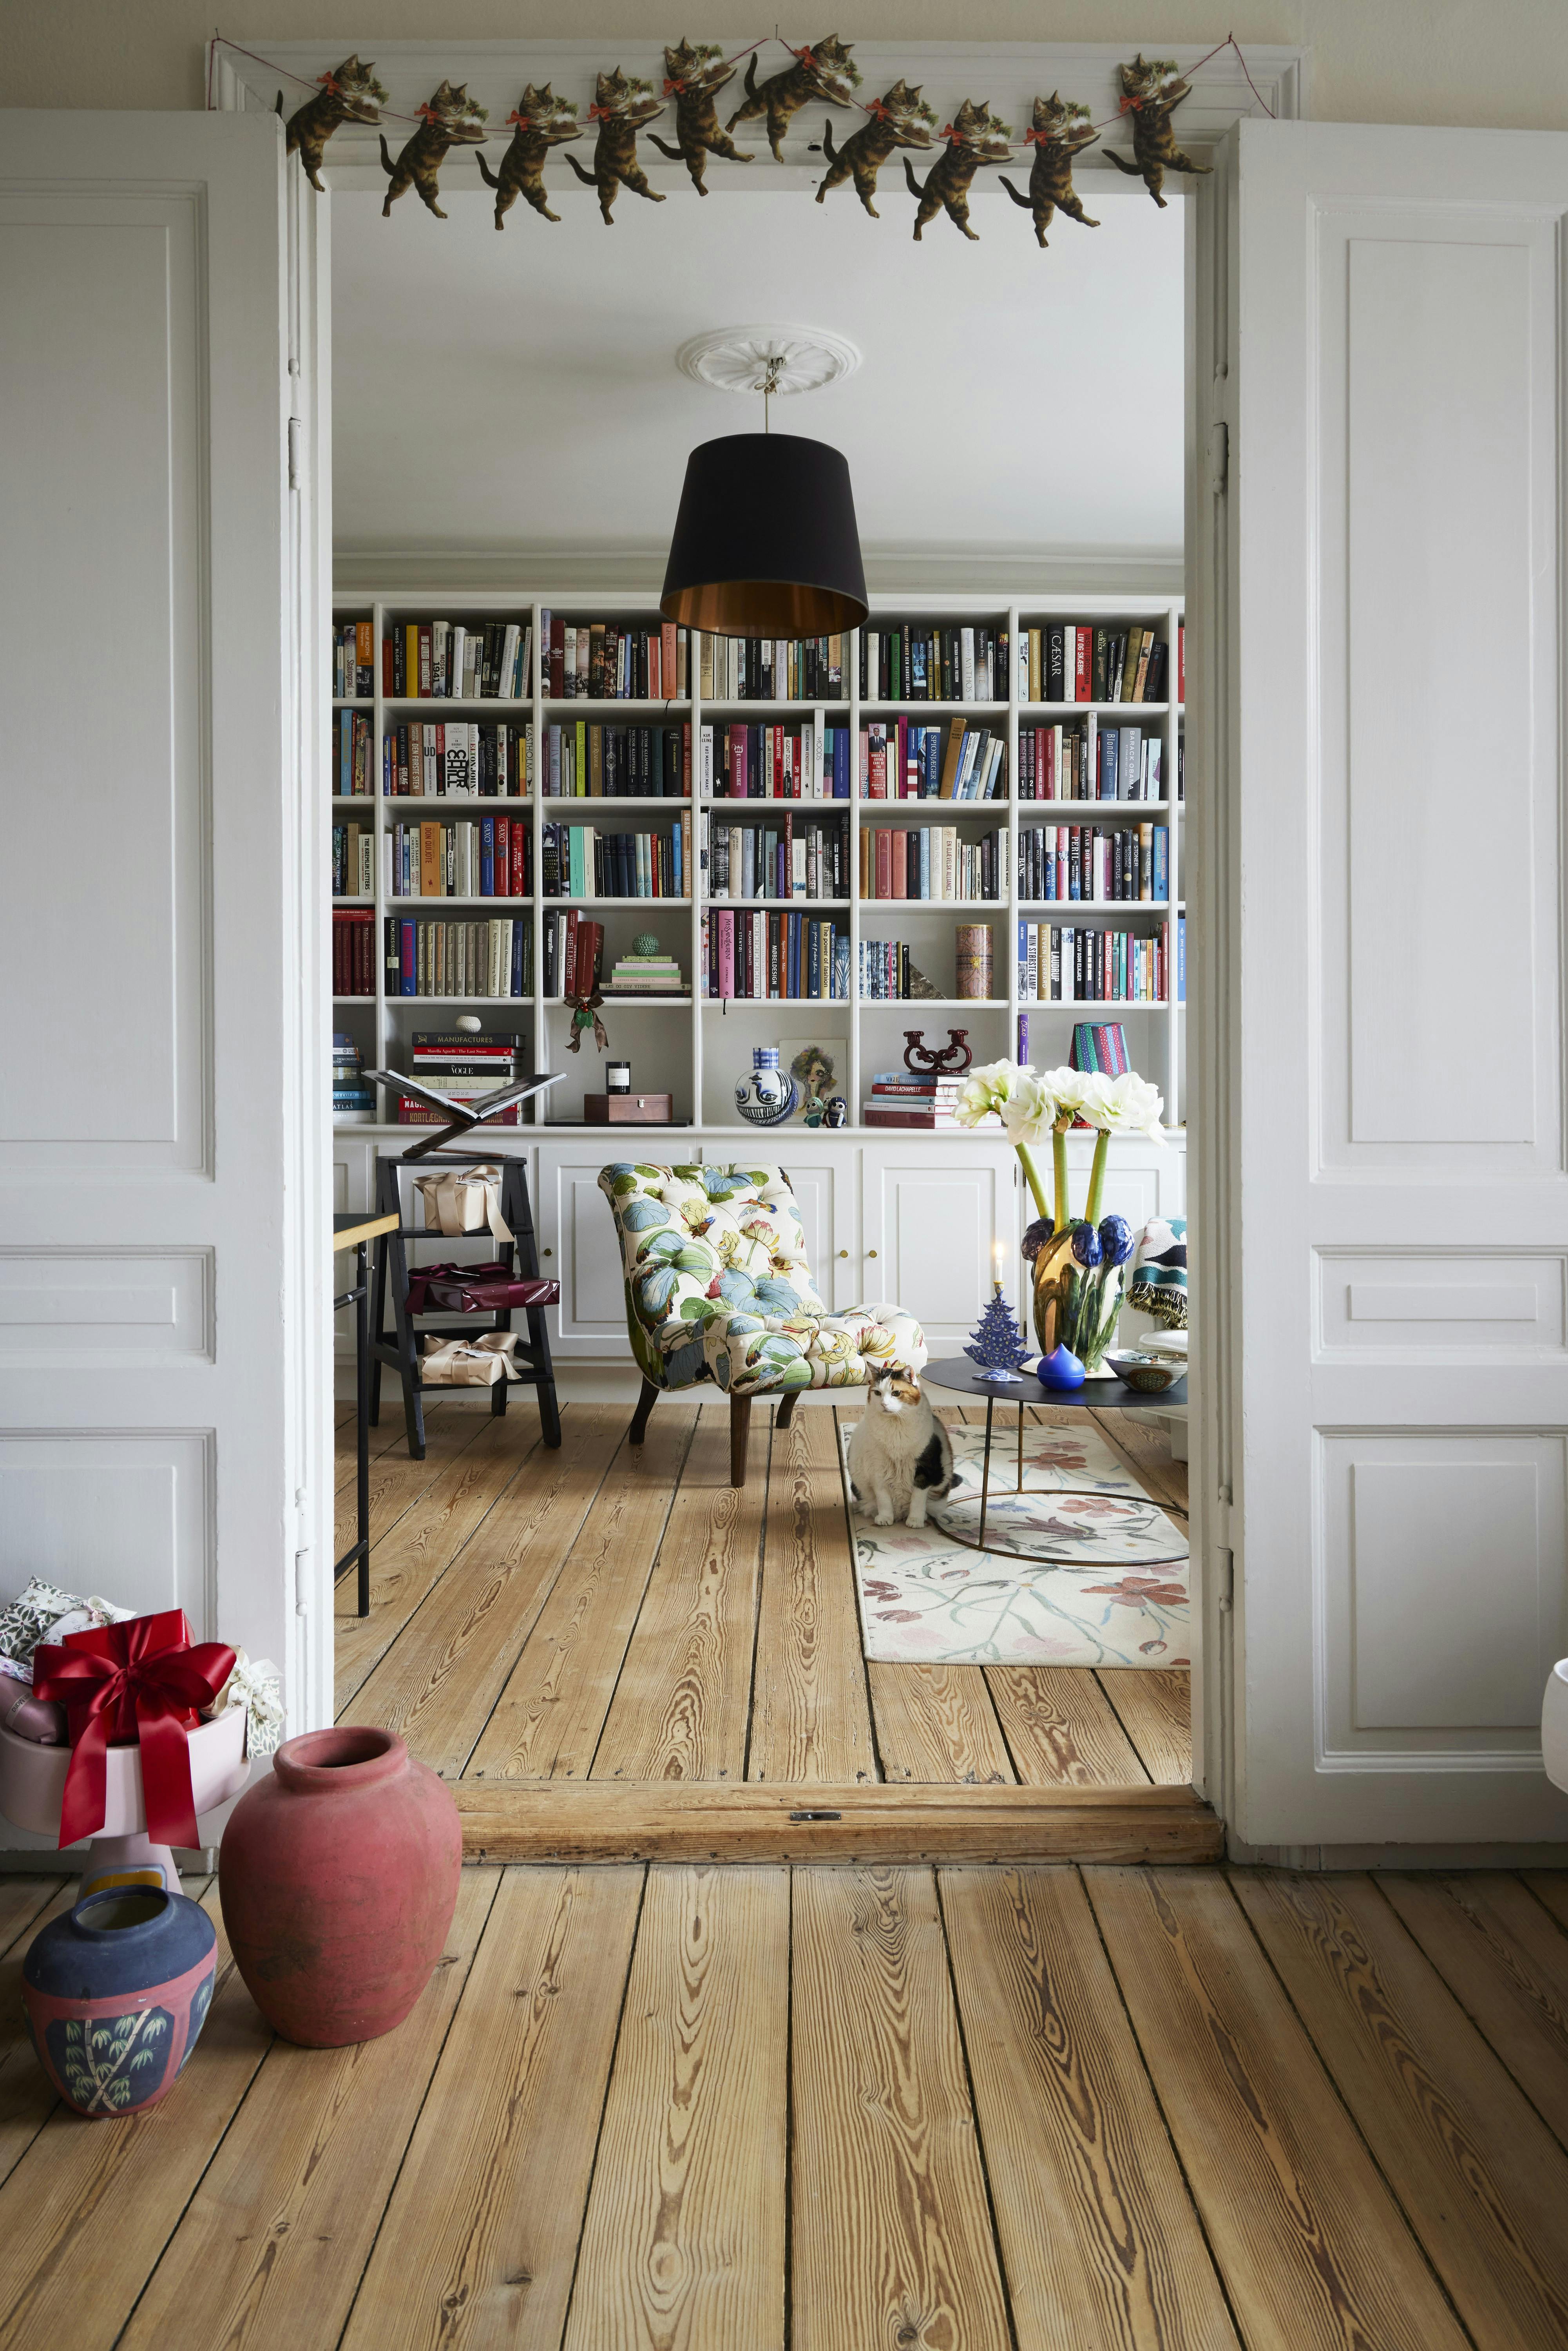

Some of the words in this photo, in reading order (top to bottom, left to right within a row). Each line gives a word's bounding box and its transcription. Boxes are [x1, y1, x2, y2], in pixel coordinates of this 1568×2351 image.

[1052, 635, 1061, 677] CÆSAR
[346, 659, 354, 688] Stalingrad
[424, 746, 436, 757] UD
[486, 737, 496, 775] Undtagelsen
[975, 747, 985, 770] MURAKAMI
[1106, 734, 1115, 766] Blondine
[1051, 951, 1059, 982] LAUDRUP
